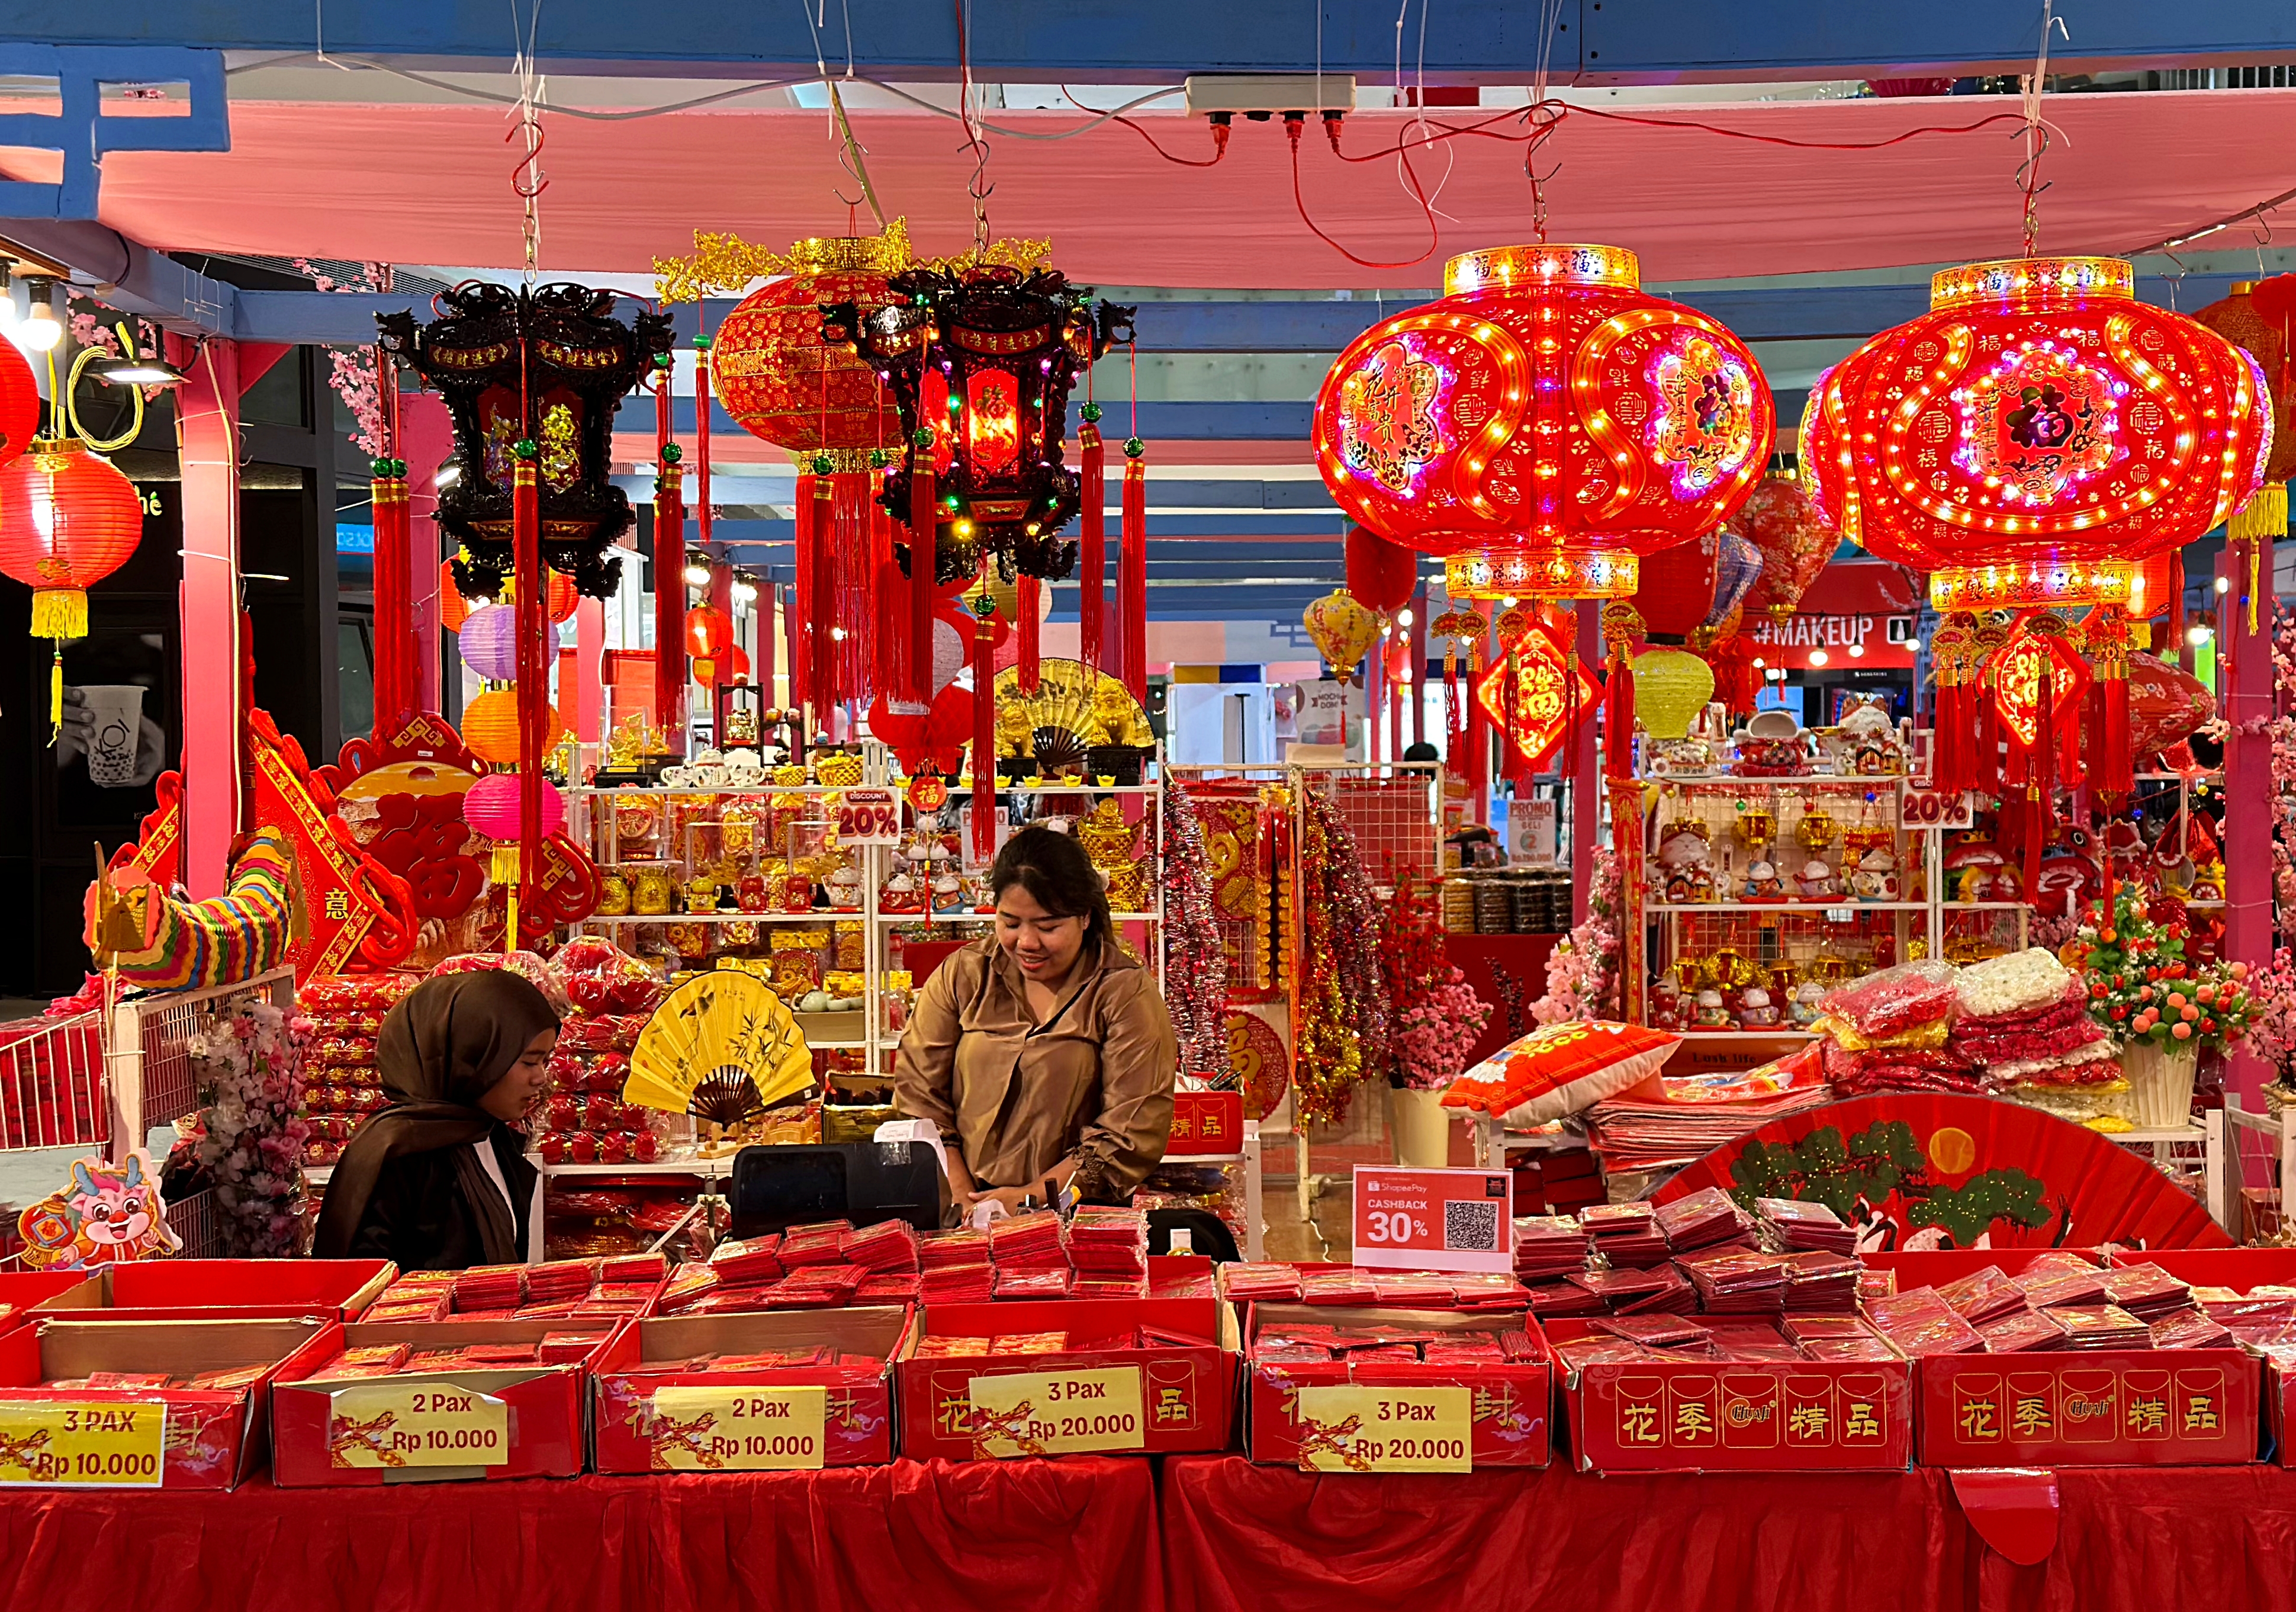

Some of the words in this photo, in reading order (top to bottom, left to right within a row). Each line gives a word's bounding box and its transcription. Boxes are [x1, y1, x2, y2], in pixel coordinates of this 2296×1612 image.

[2006, 384, 2074, 448] 福
[1752, 617, 1873, 646] #MAKEUP
[850, 791, 886, 800] DISCOUNT
[917, 783, 939, 804] 福
[1510, 801, 1553, 817] PROMO
[1903, 792, 1967, 821] 20%
[838, 805, 898, 836] 20%
[324, 888, 349, 920] 意
[1381, 1183, 1427, 1194] ShopeePay
[1368, 1199, 1428, 1210] CASHBACK
[1367, 1211, 1428, 1243] 30%
[1048, 1382, 1061, 1401] 3
[1067, 1382, 1106, 1399] Pax
[413, 1394, 426, 1412] 2
[432, 1393, 472, 1412] Pax
[732, 1399, 745, 1417] 2
[751, 1399, 790, 1417] Pax
[1156, 1388, 1189, 1422] 品
[1378, 1402, 1390, 1420] 3
[1397, 1402, 1436, 1421] Pax
[64, 1411, 78, 1431] 3
[85, 1411, 136, 1432] PAX
[1028, 1420, 1056, 1441] Rp
[1062, 1414, 1135, 1437] 20.000
[393, 1431, 421, 1453] Rp
[427, 1429, 497, 1449] 10.000
[712, 1436, 739, 1458] Rp
[745, 1436, 813, 1455] 10.000
[1355, 1440, 1384, 1461] Rp
[1389, 1440, 1464, 1459] 20.000
[37, 1453, 70, 1478] Rp
[78, 1453, 156, 1475] 10.000
